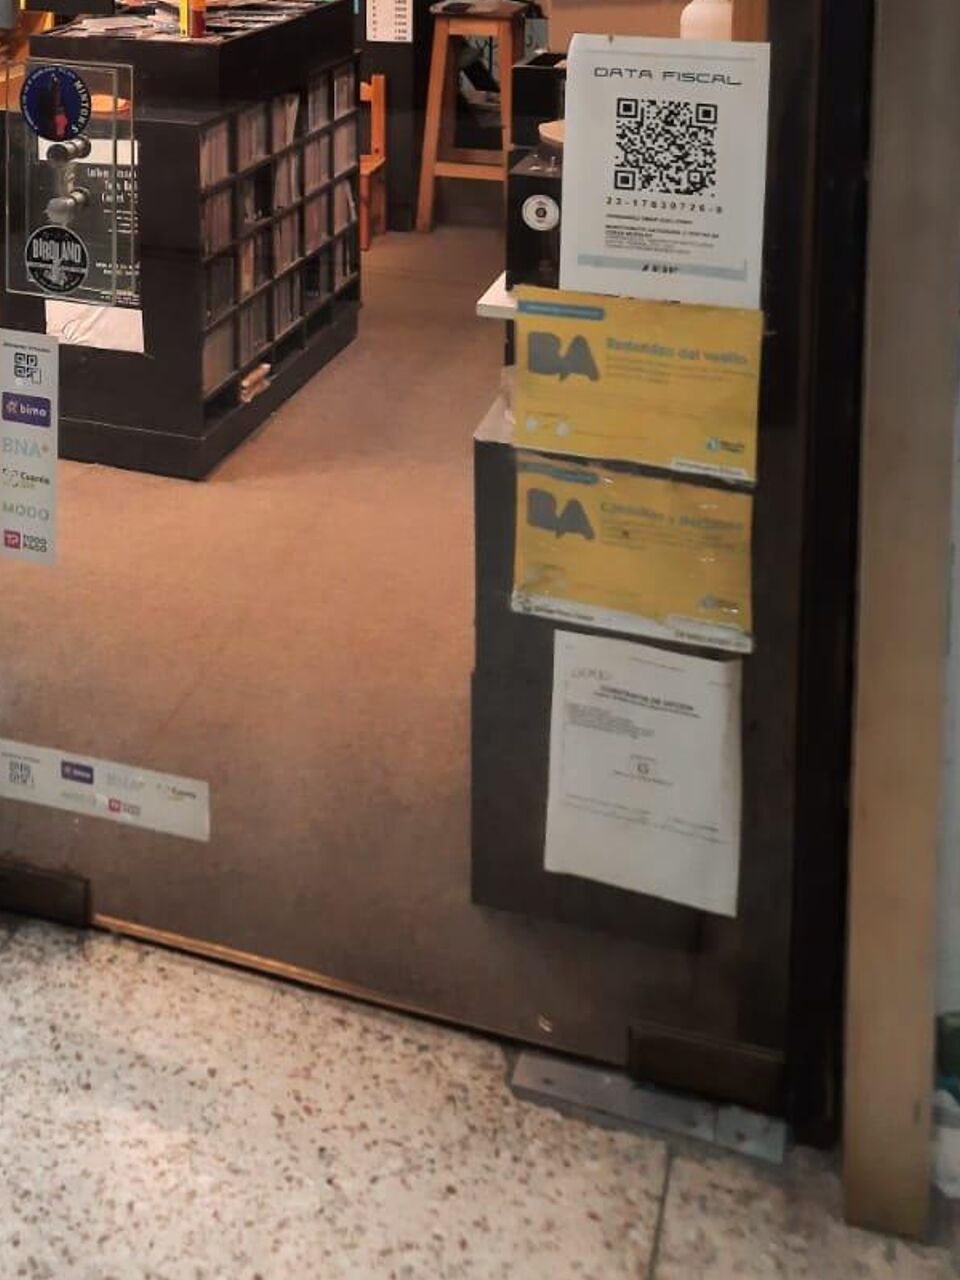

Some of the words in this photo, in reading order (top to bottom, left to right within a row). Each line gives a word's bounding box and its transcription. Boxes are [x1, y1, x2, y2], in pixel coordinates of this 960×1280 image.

[594, 67, 653, 80] DATA
[662, 71, 743, 86] FISCAL
[72, 79, 89, 134] MINTON'S
[32, 237, 81, 263] BIRDLAND
[527, 331, 599, 381] BA
[2, 502, 49, 521] MODO
[526, 487, 596, 540] BA
